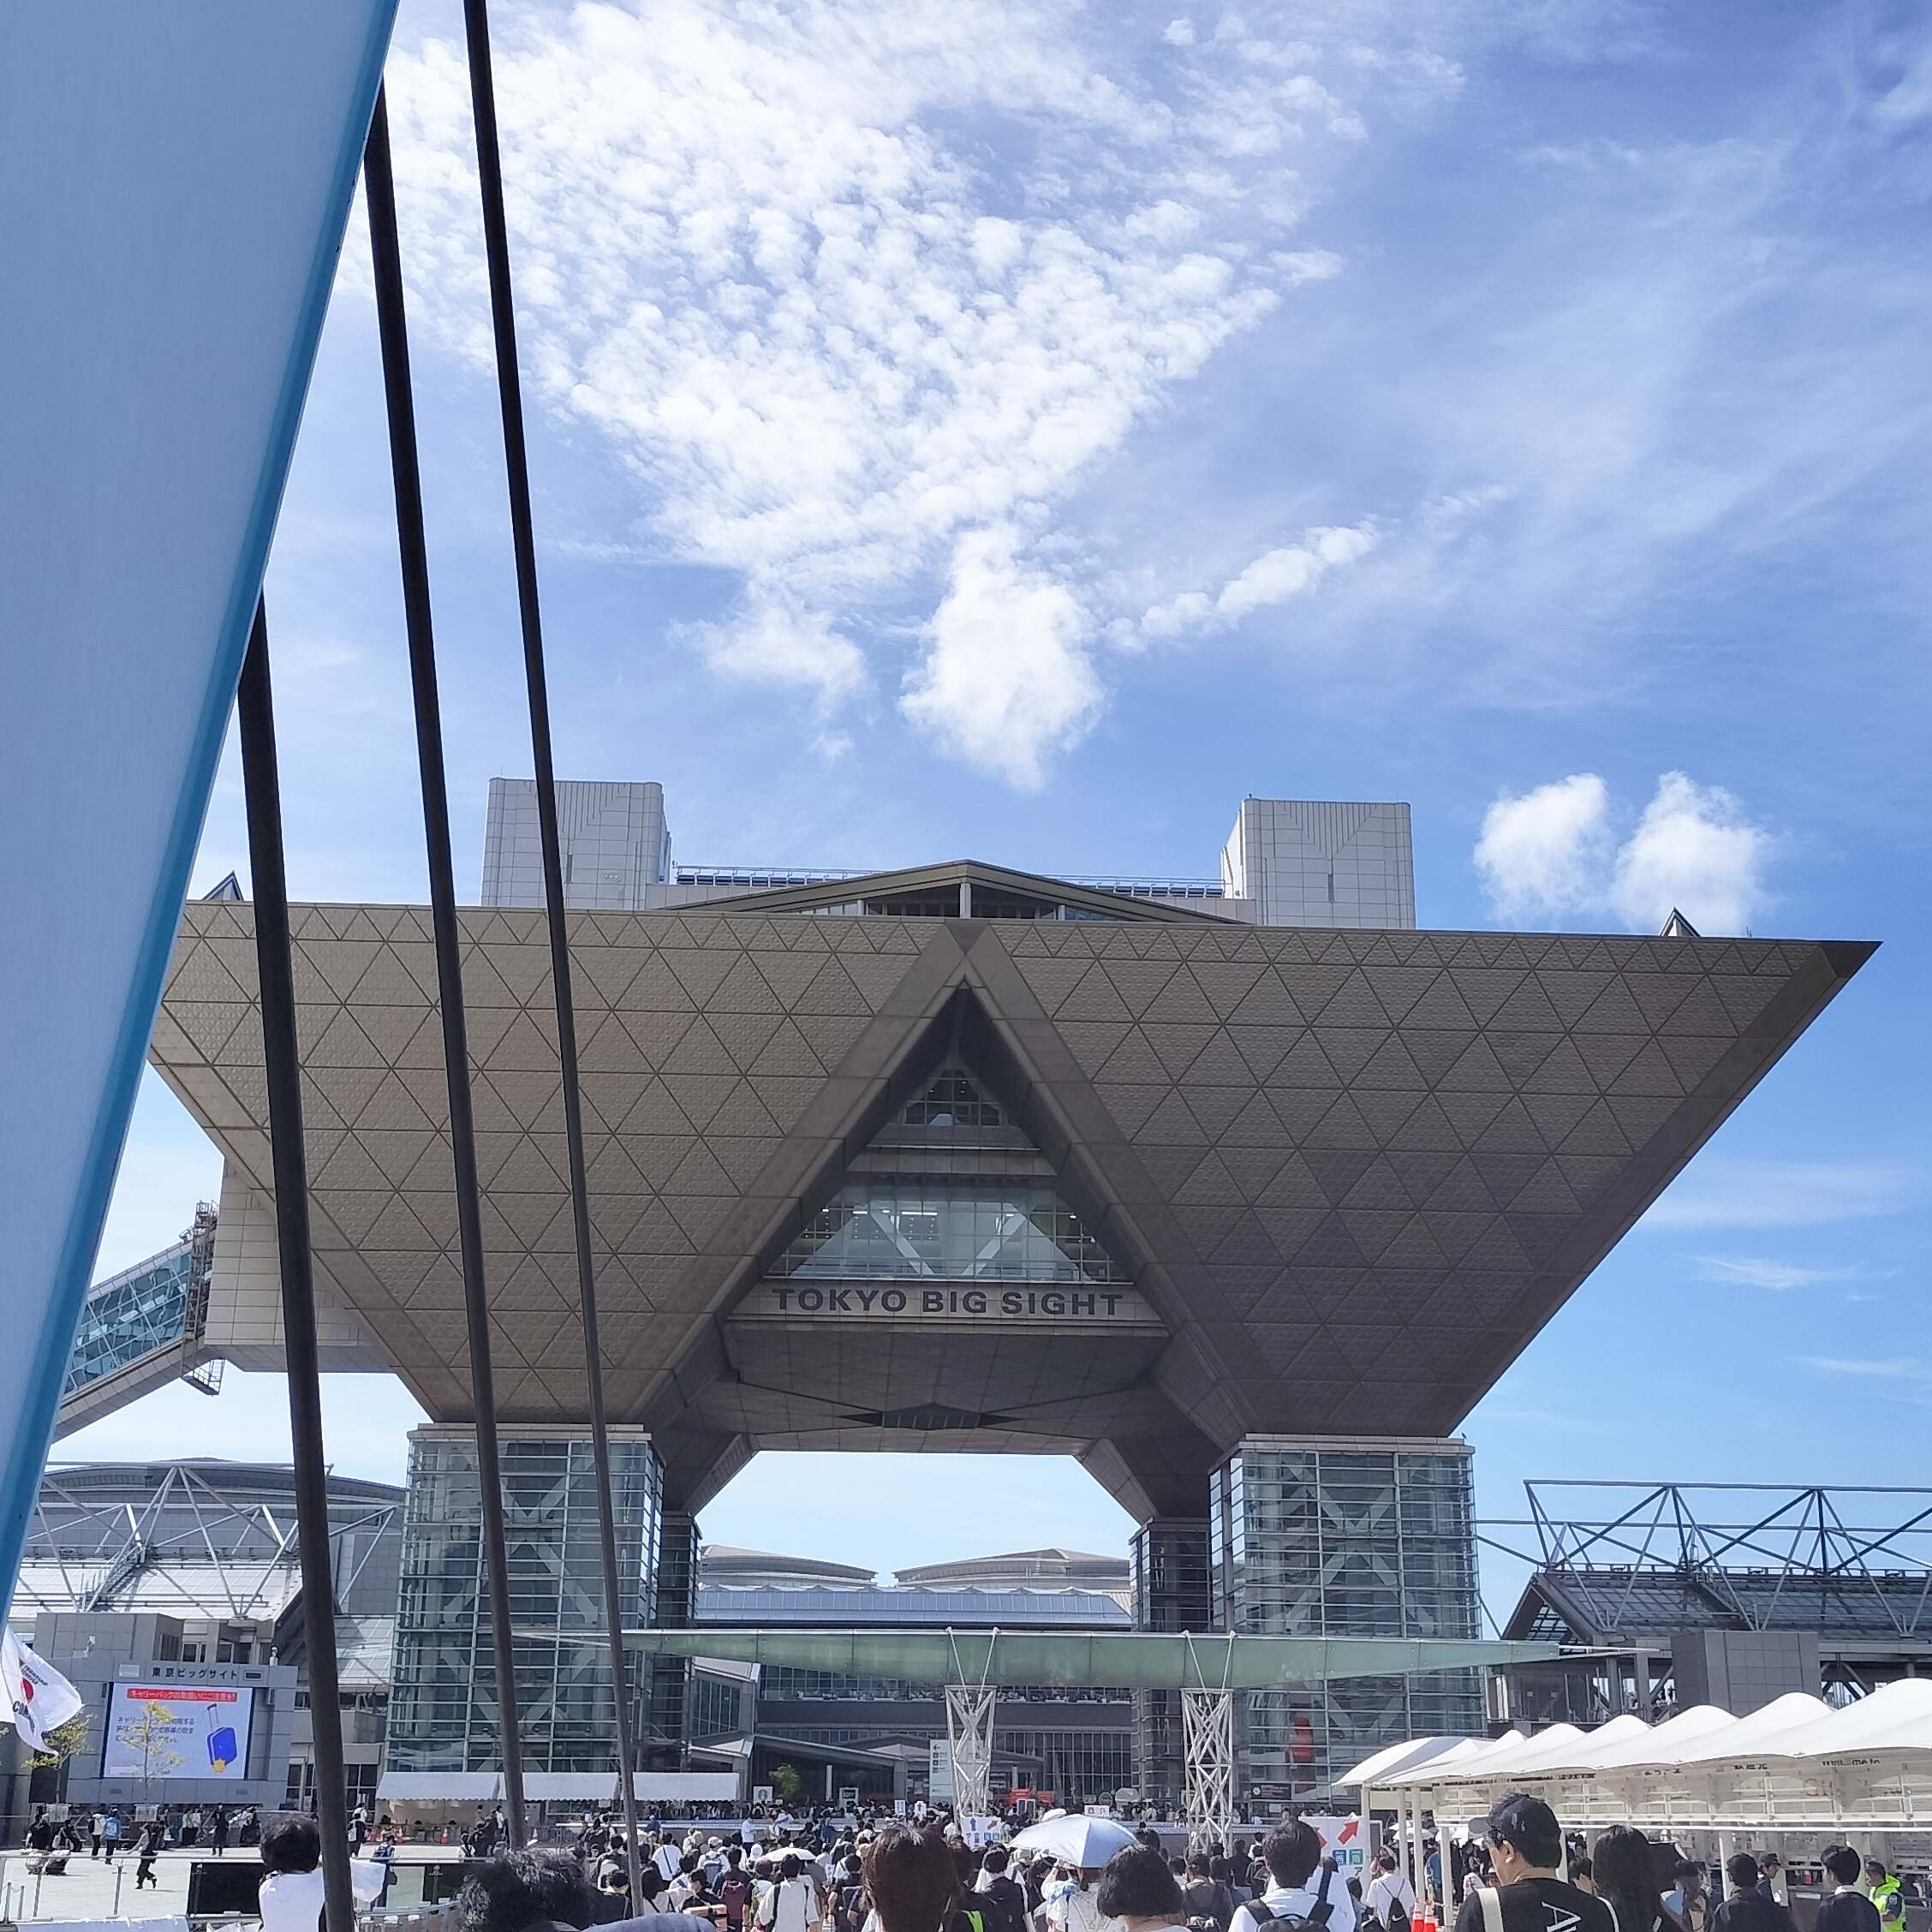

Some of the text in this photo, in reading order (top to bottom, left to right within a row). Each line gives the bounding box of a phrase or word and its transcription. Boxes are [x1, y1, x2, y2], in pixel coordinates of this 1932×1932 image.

[772, 1289, 1123, 1315] TOKYO BIG SIGHT
[152, 1667, 237, 1679] 東京ビッグサイト
